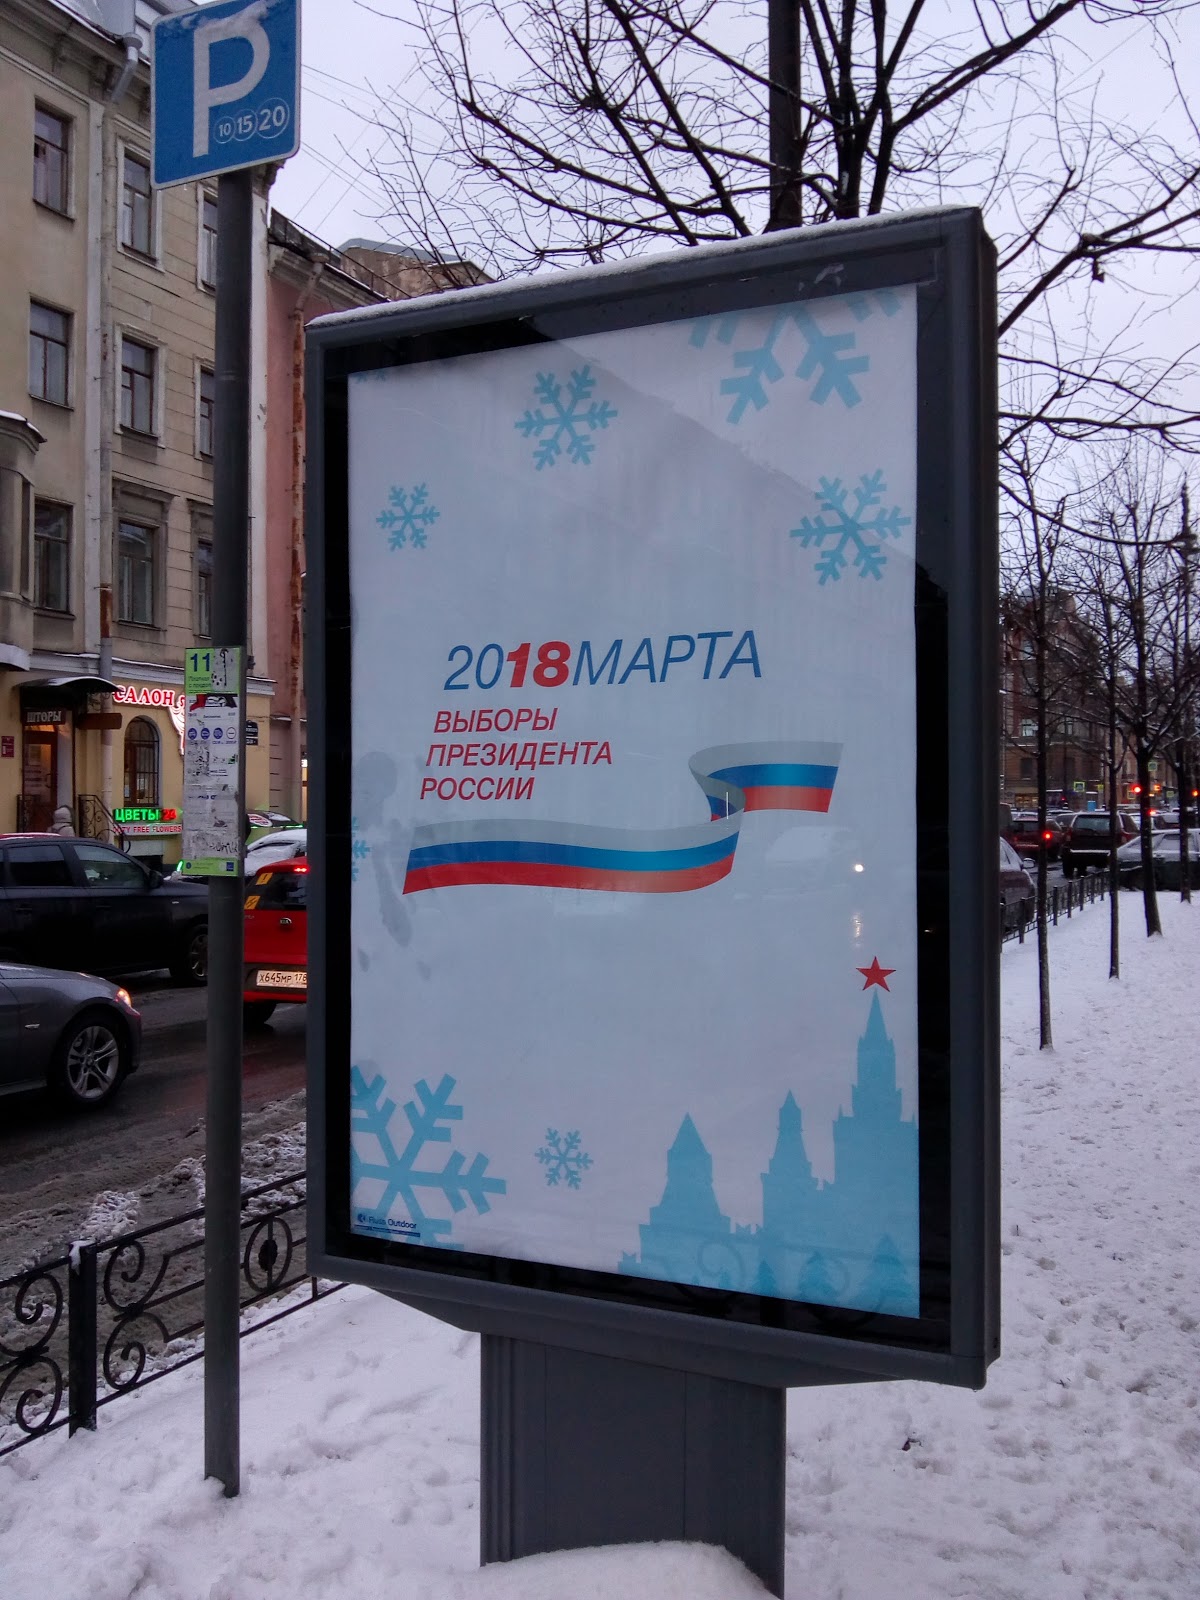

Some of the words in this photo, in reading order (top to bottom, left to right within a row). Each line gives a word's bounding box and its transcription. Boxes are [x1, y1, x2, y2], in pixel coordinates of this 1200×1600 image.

[193, 20, 270, 158] P
[218, 122, 232, 138] 10
[236, 115, 252, 134] 15
[258, 105, 286, 131] 20
[190, 653, 210, 672] 11
[114, 686, 174, 706] САЛОН
[27, 711, 62, 722] ШТОРЫ
[434, 708, 558, 733] ВЫБОРЫ
[425, 741, 613, 770] ПРЕЗИДЕНТА
[420, 777, 535, 801] РОССИИ
[115, 809, 159, 822] ЦВЕТЫ
[163, 808, 176, 821] 24
[388, 1218, 417, 1229] Outdoor
